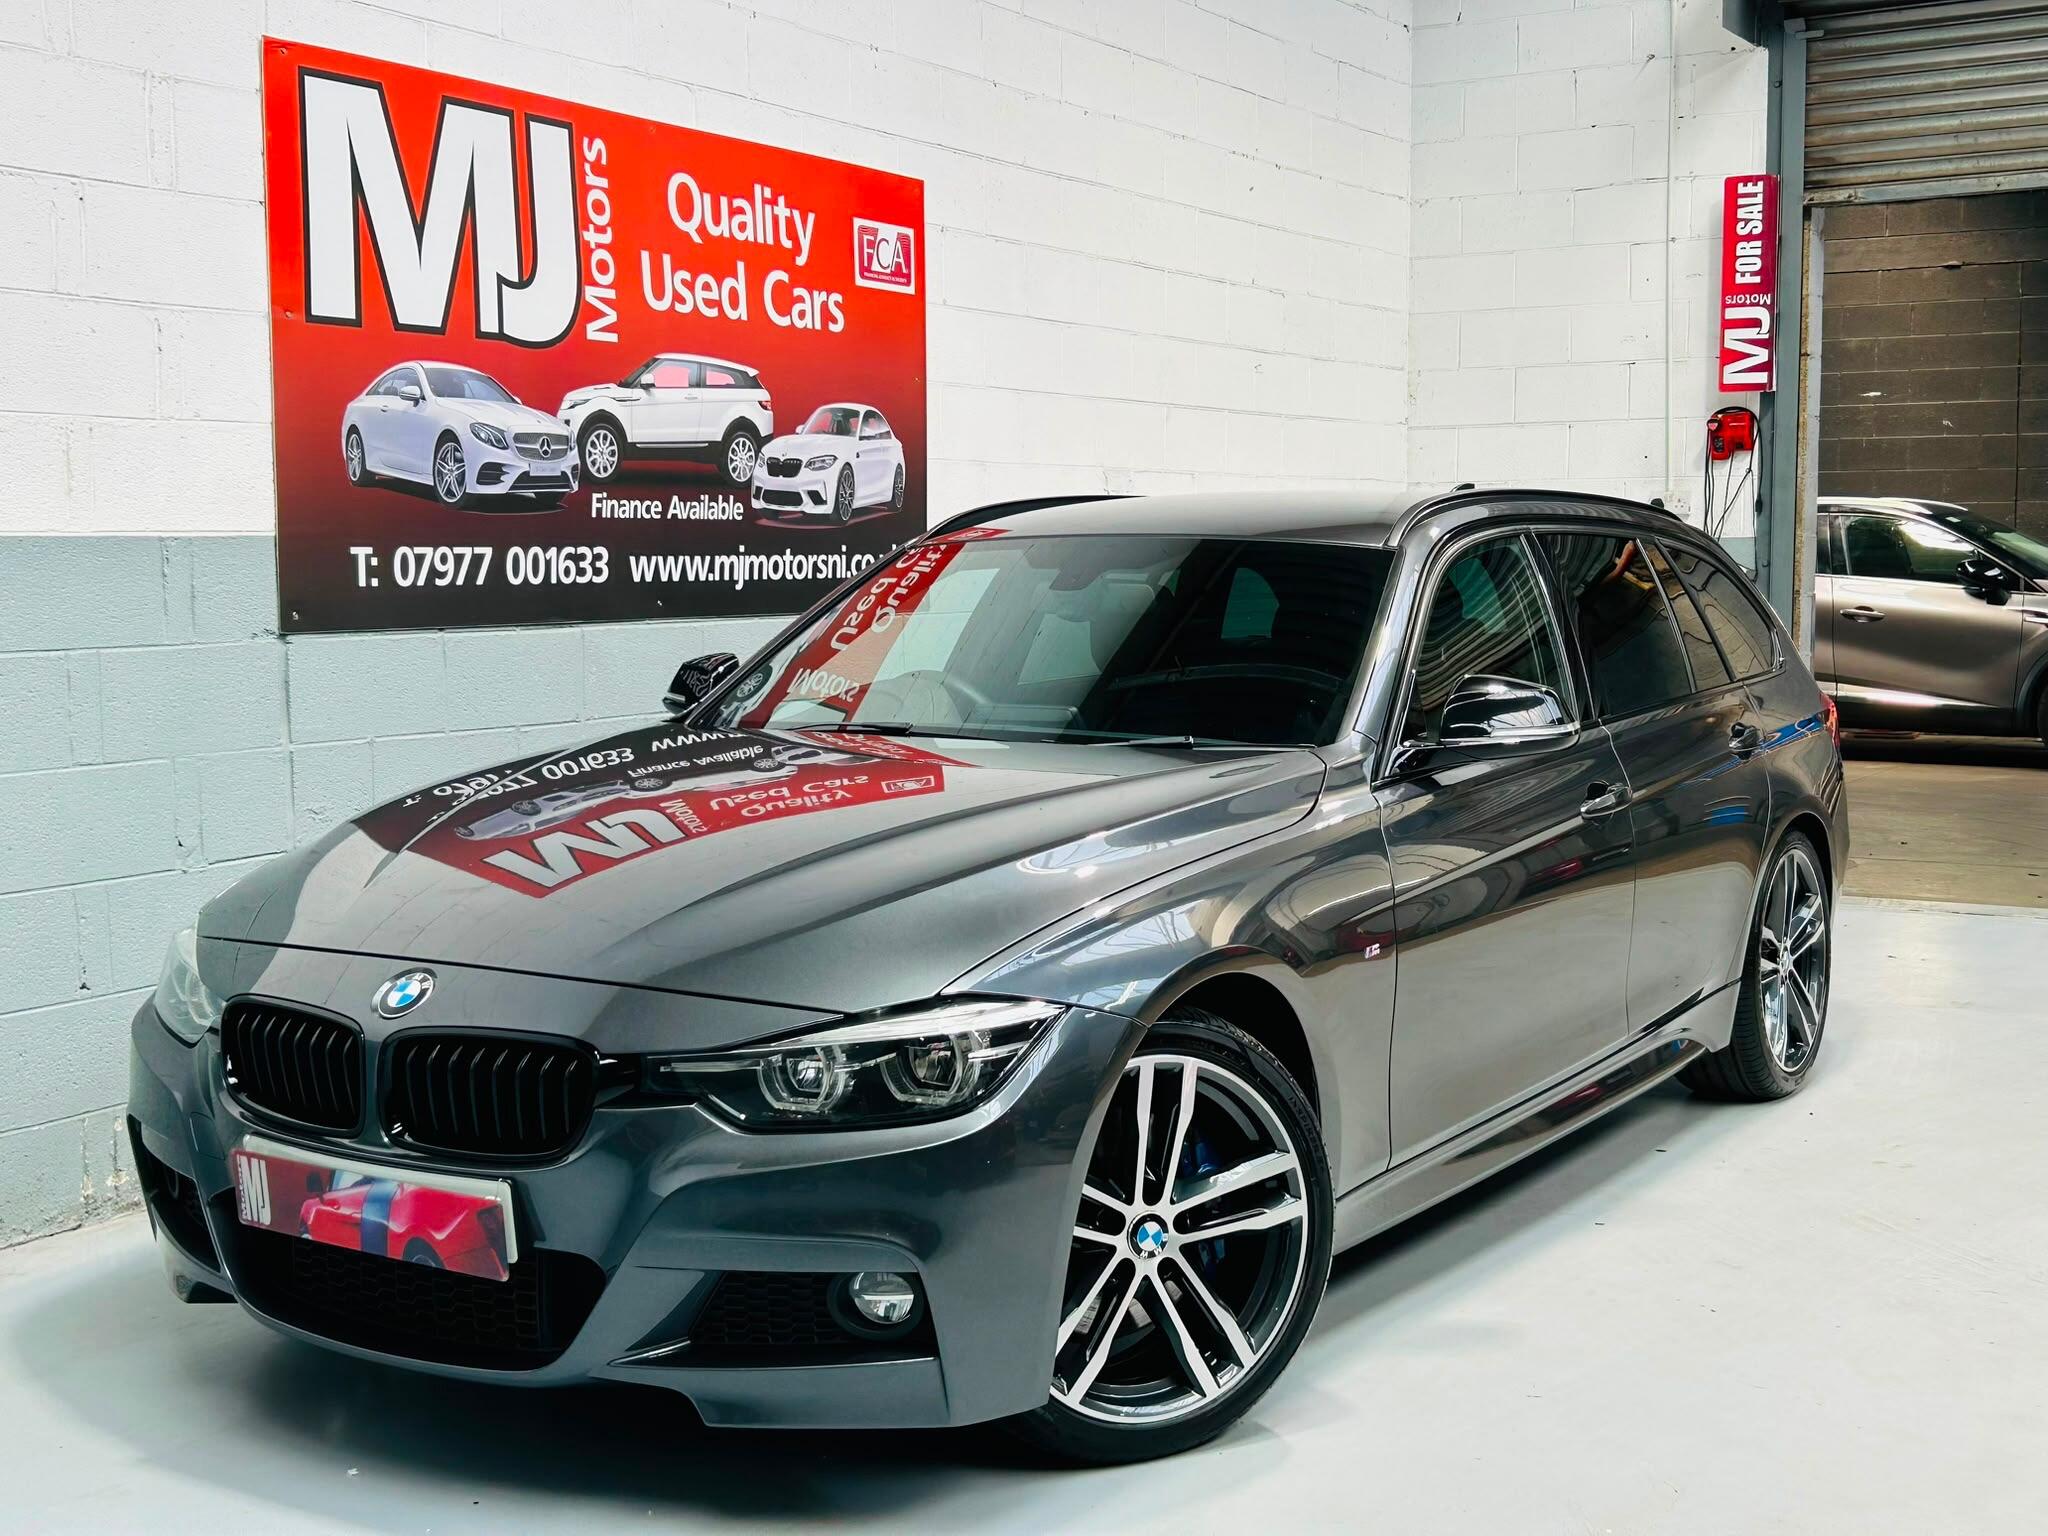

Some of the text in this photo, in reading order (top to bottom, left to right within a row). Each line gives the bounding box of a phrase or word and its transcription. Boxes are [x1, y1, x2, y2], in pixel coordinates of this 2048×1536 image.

[301, 70, 579, 347] MJ
[584, 136, 619, 343] Motors
[667, 172, 816, 266] Quality
[1735, 180, 1764, 284] FOR SALE
[640, 249, 845, 334] Used Cars
[863, 234, 909, 274] FCA
[1725, 294, 1771, 305] Motors
[1722, 306, 1771, 385] MJ
[591, 491, 744, 522] Finance Available
[350, 546, 379, 588] T:
[393, 545, 492, 587] 07977
[506, 545, 610, 586] 001633
[240, 1155, 271, 1225] MJ
